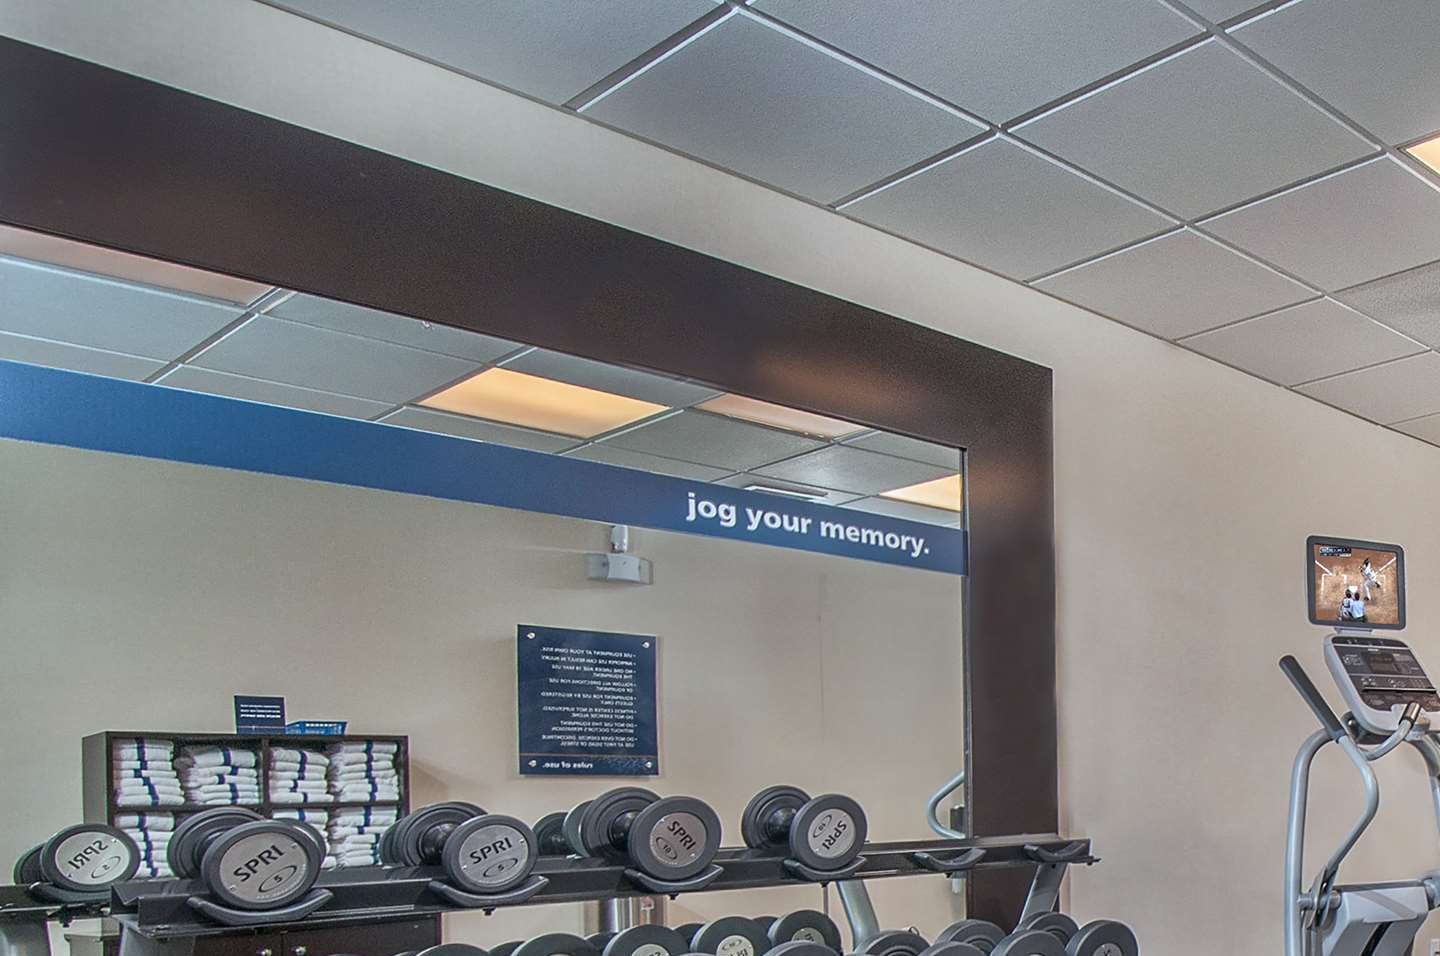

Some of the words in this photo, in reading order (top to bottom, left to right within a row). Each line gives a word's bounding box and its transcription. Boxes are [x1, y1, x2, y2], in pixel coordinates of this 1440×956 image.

[686, 492, 737, 527] jog
[745, 508, 811, 531] your
[820, 519, 929, 557] memory.
[667, 820, 697, 852] SPRI
[822, 820, 847, 850] SPRI
[232, 843, 282, 883] SPRI
[469, 837, 513, 865] SPRI
[274, 874, 283, 886] 5
